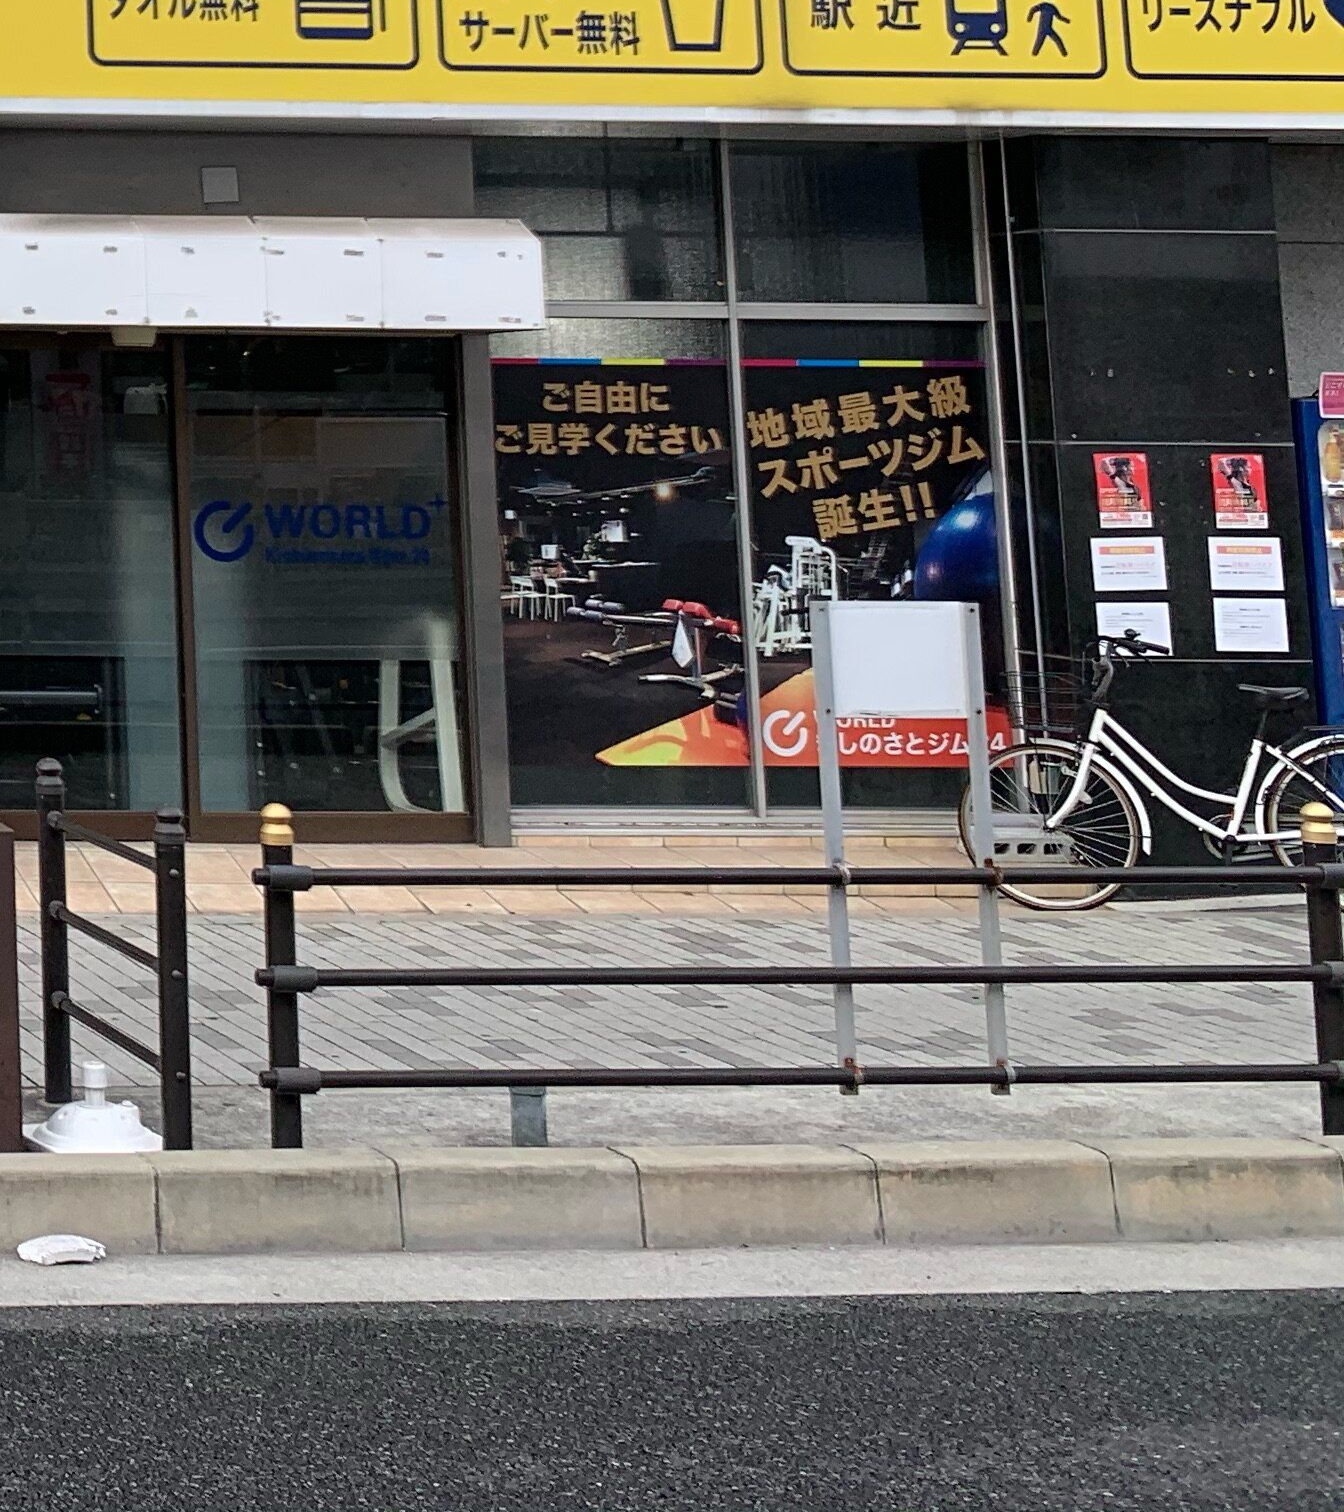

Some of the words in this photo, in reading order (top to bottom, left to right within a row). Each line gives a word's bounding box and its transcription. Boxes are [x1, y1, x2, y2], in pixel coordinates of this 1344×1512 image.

[458, 9, 641, 57] サーバー無料
[542, 381, 671, 414] ご自由に
[746, 375, 972, 449] 地域最大級
[495, 423, 725, 457] ご見学ください
[758, 426, 985, 498] スポーツジム
